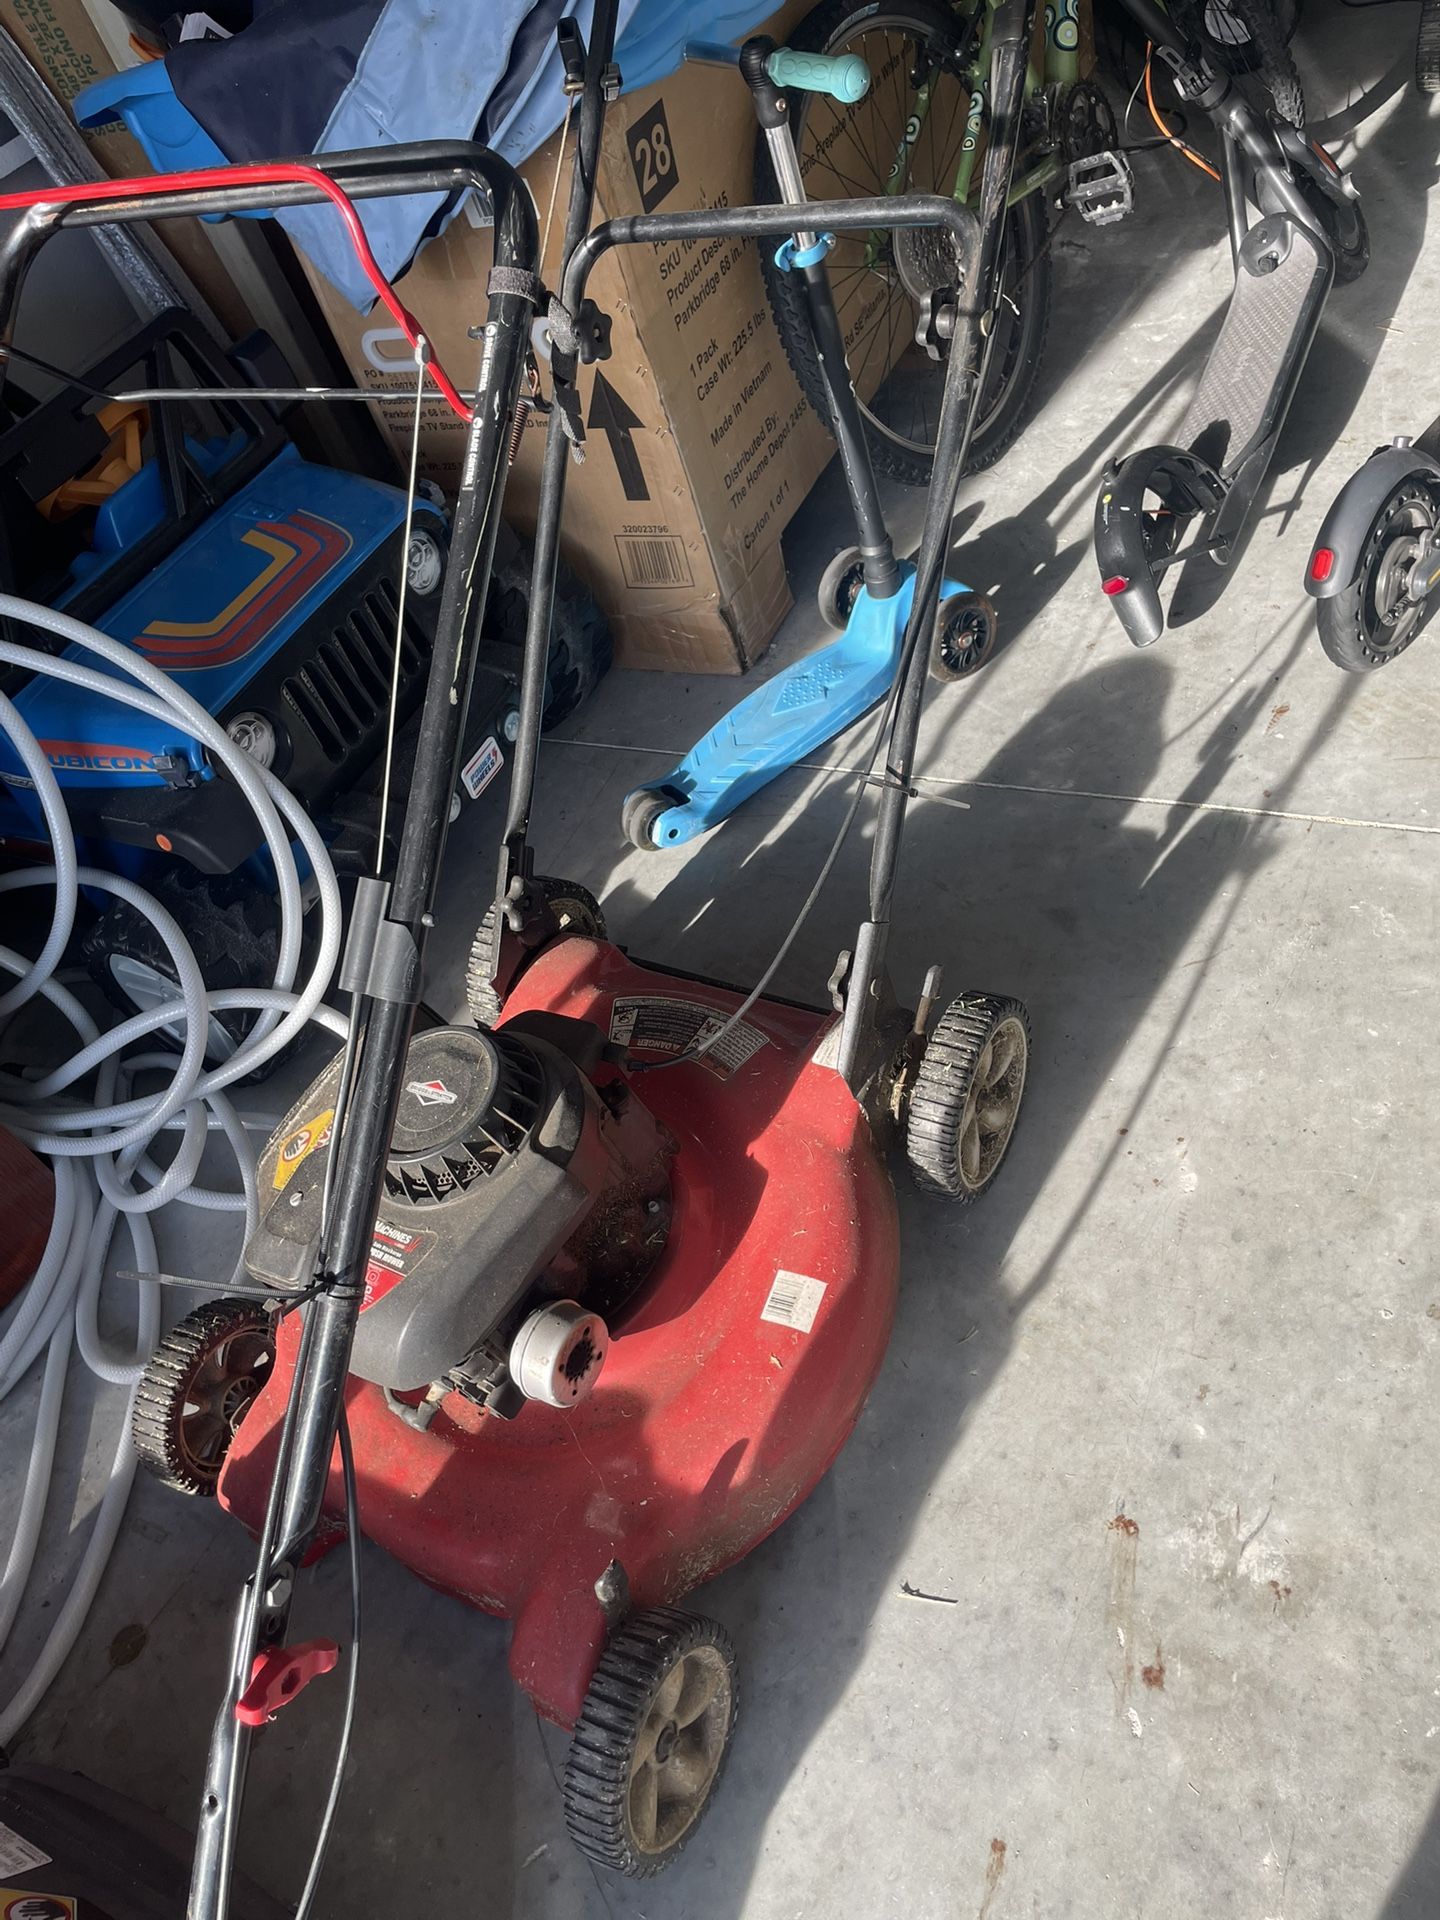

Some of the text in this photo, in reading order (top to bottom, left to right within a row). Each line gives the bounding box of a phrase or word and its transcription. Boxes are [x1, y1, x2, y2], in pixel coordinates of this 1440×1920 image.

[25, 23, 73, 100] CONSOLE
[635, 123, 671, 196] 28
[660, 247, 682, 281] SKU
[667, 258, 703, 307] Product
[674, 271, 721, 332] Parkbridge
[720, 254, 731, 276] 68
[730, 246, 743, 265] in.
[364, 369, 378, 379] PO
[478, 359, 491, 392] CONTROL
[689, 338, 719, 378] 1 Pack
[697, 370, 719, 401] Case
[732, 320, 755, 357] 225.5
[752, 308, 767, 330] lbs
[427, 422, 438, 432] TV
[710, 361, 773, 448] Made in Vietnam
[464, 429, 481, 486] BLADE CONTROL
[723, 411, 781, 490] Distributed By:
[730, 397, 809, 509] The Home Depot 2455
[622, 524, 671, 535] 320023796
[743, 511, 770, 550] Carton
[775, 487, 786, 505] of
[48, 753, 156, 770] UBICON
[637, 1039, 672, 1051] DANGER
